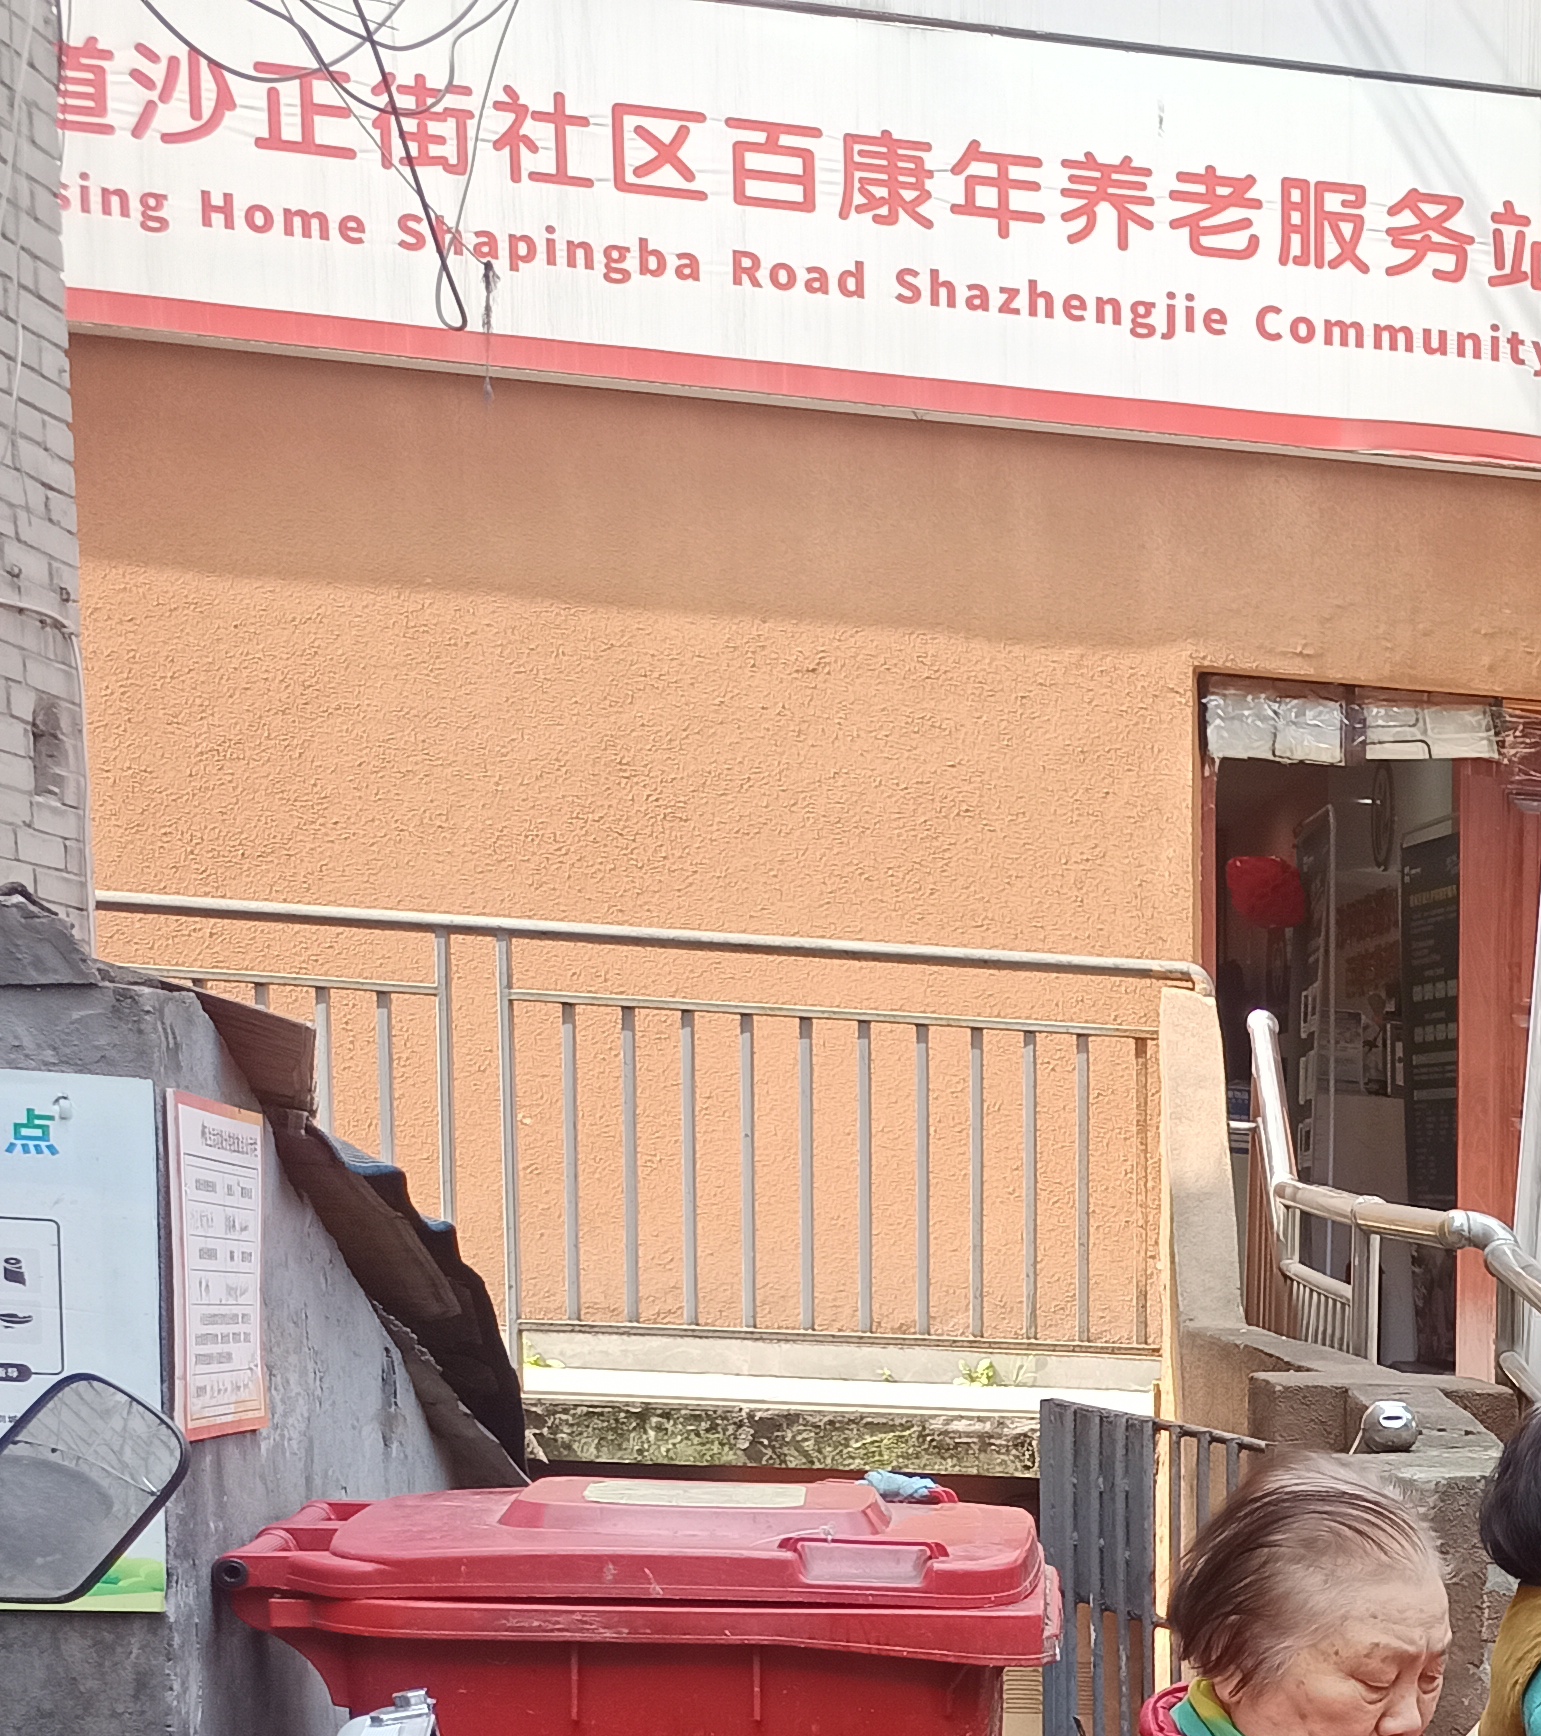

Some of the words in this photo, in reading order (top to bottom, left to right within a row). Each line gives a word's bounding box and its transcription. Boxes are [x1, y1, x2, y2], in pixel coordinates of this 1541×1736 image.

[200, 189, 367, 246] Home
[398, 212, 702, 285] Shapingba
[732, 249, 866, 300] Road
[894, 266, 1229, 340] Shazhengjie
[5, 1107, 60, 1156] 点
